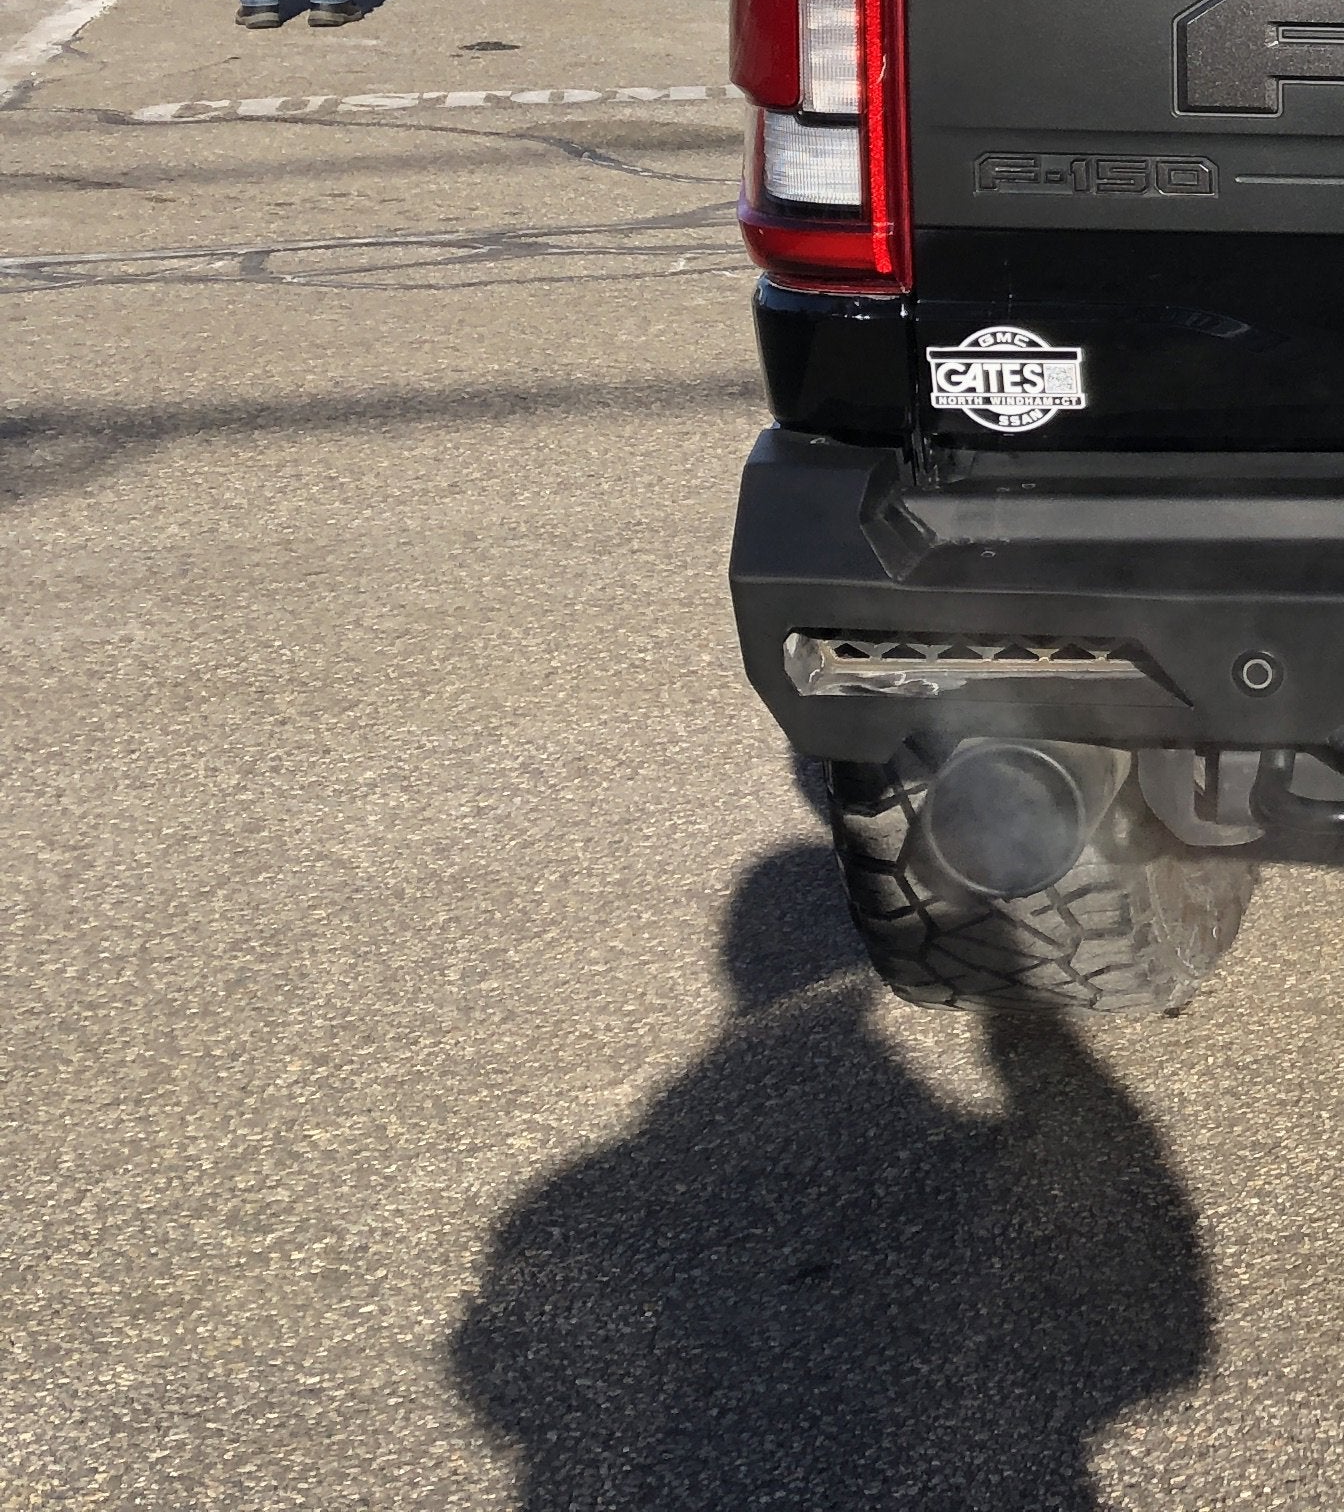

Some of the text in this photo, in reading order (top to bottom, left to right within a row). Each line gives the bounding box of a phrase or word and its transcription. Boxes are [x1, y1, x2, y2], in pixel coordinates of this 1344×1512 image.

[975, 153, 1218, 197] F-150
[978, 332, 1029, 348] GMC
[936, 362, 1045, 393] GATES
[938, 396, 983, 405] NORTH
